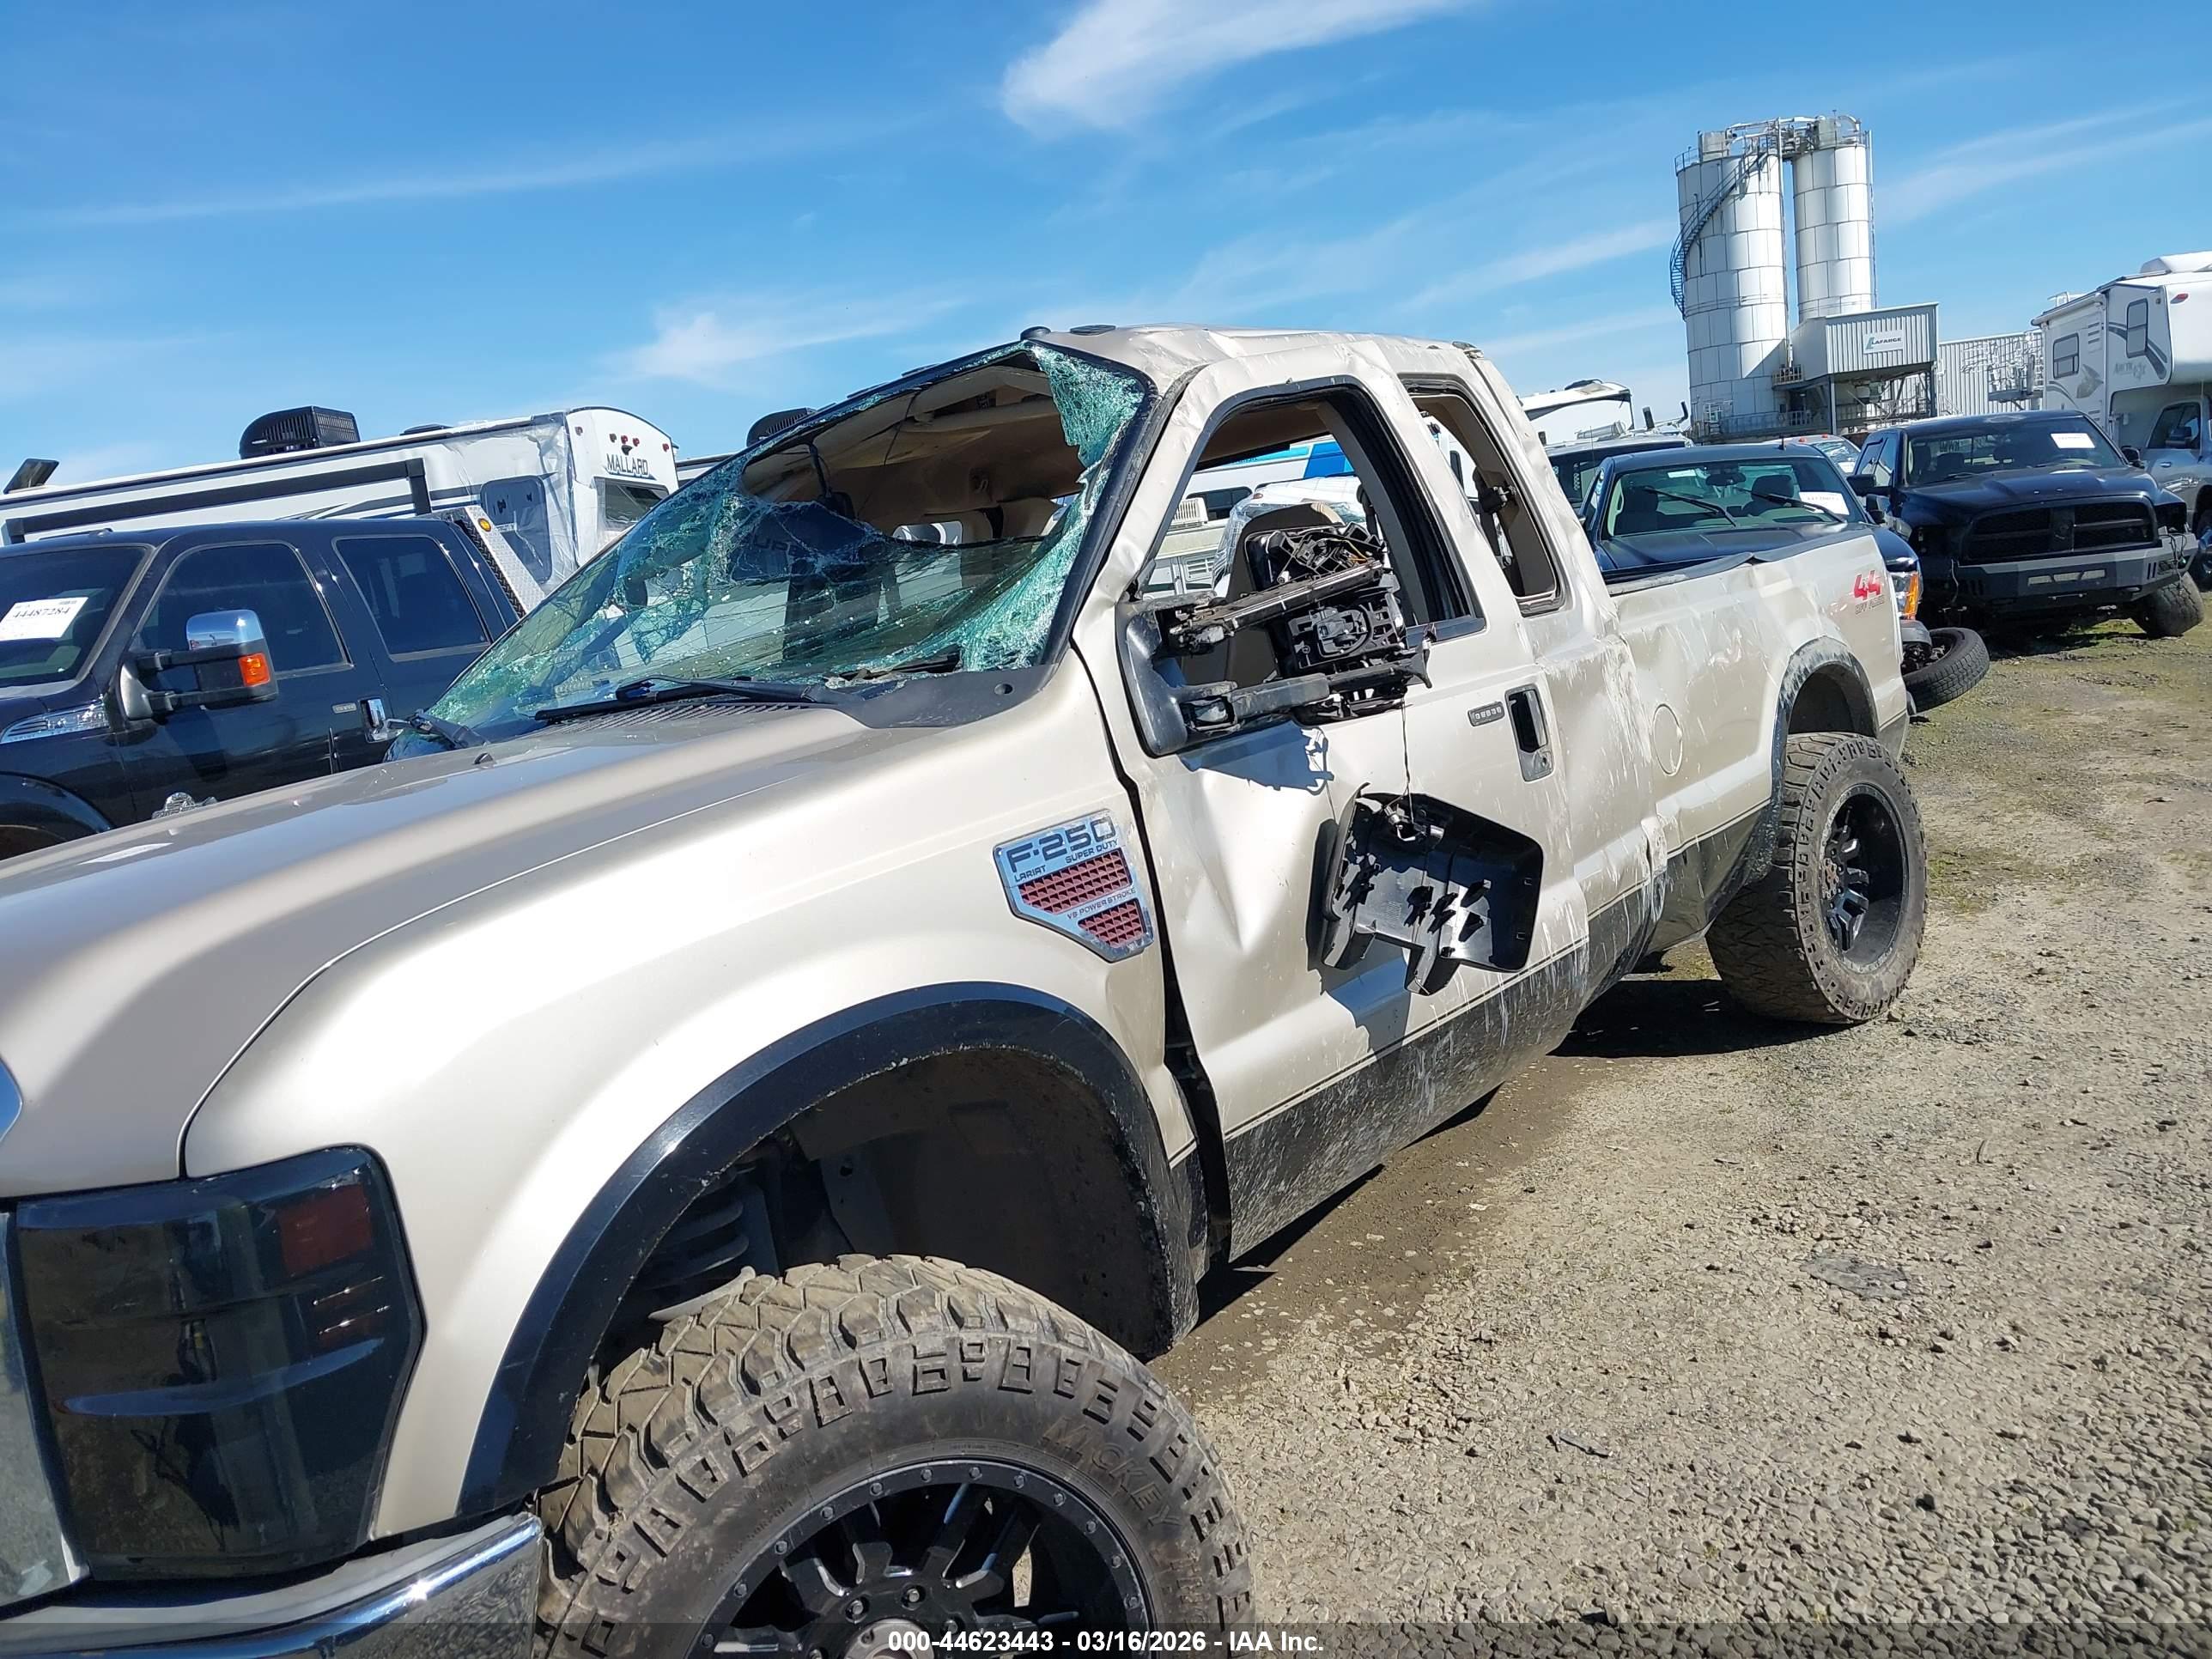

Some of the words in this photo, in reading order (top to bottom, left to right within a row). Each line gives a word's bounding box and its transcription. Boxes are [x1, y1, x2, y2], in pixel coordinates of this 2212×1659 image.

[606, 453, 648, 475] MALLARD
[1014, 865, 1047, 883] LARIAT
[1066, 848, 1095, 864] SUPER
[1097, 839, 1119, 853] DUTY
